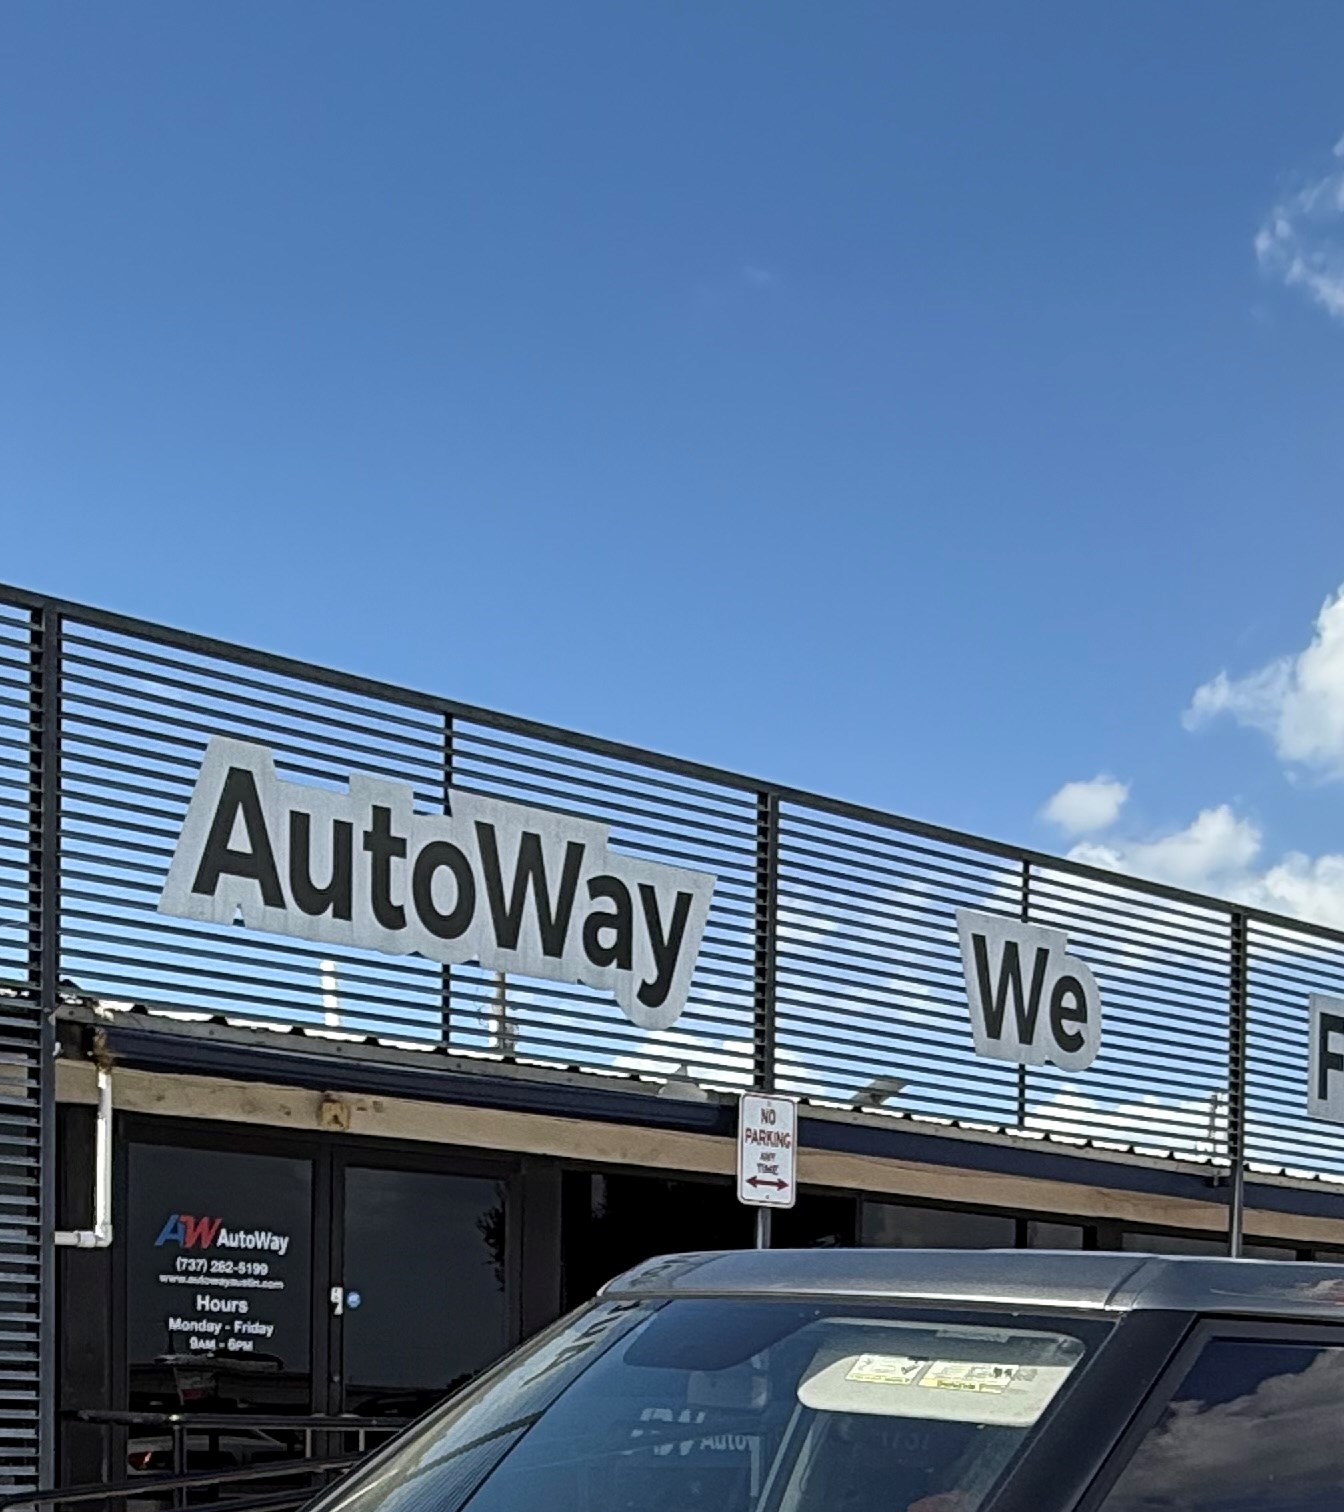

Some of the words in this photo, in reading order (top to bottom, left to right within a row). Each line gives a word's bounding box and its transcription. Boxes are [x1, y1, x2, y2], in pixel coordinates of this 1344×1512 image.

[192, 766, 694, 1008] AutoWay
[970, 933, 1089, 1053] We
[760, 1108, 777, 1125] NO
[745, 1127, 792, 1149] PARKING
[217, 1228, 289, 1255] AutoWay
[176, 1256, 208, 1273] (737)
[196, 1294, 249, 1313] Hours
[168, 1317, 223, 1335] Monday
[233, 1320, 275, 1338] Friday
